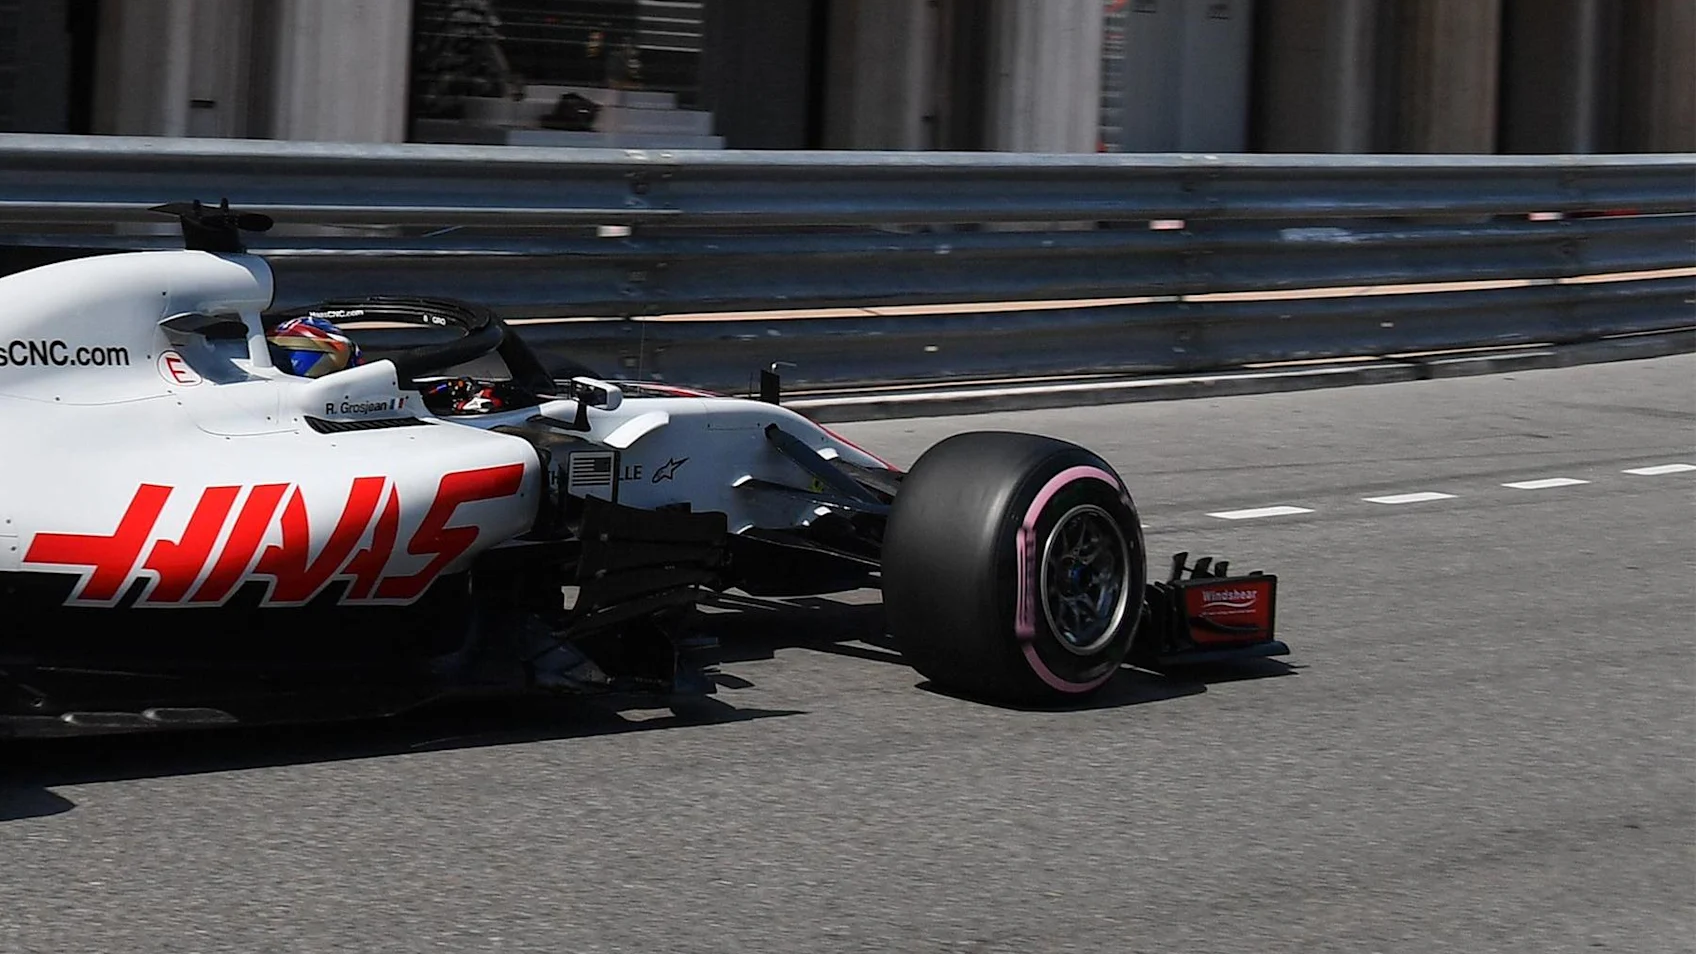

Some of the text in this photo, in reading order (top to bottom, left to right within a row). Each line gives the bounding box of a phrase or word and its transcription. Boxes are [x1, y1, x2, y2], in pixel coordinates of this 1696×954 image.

[165, 357, 197, 384] E
[326, 401, 388, 415] R. Grosjean
[22, 462, 526, 606] HAAS
[1202, 589, 1258, 603] Windshear
